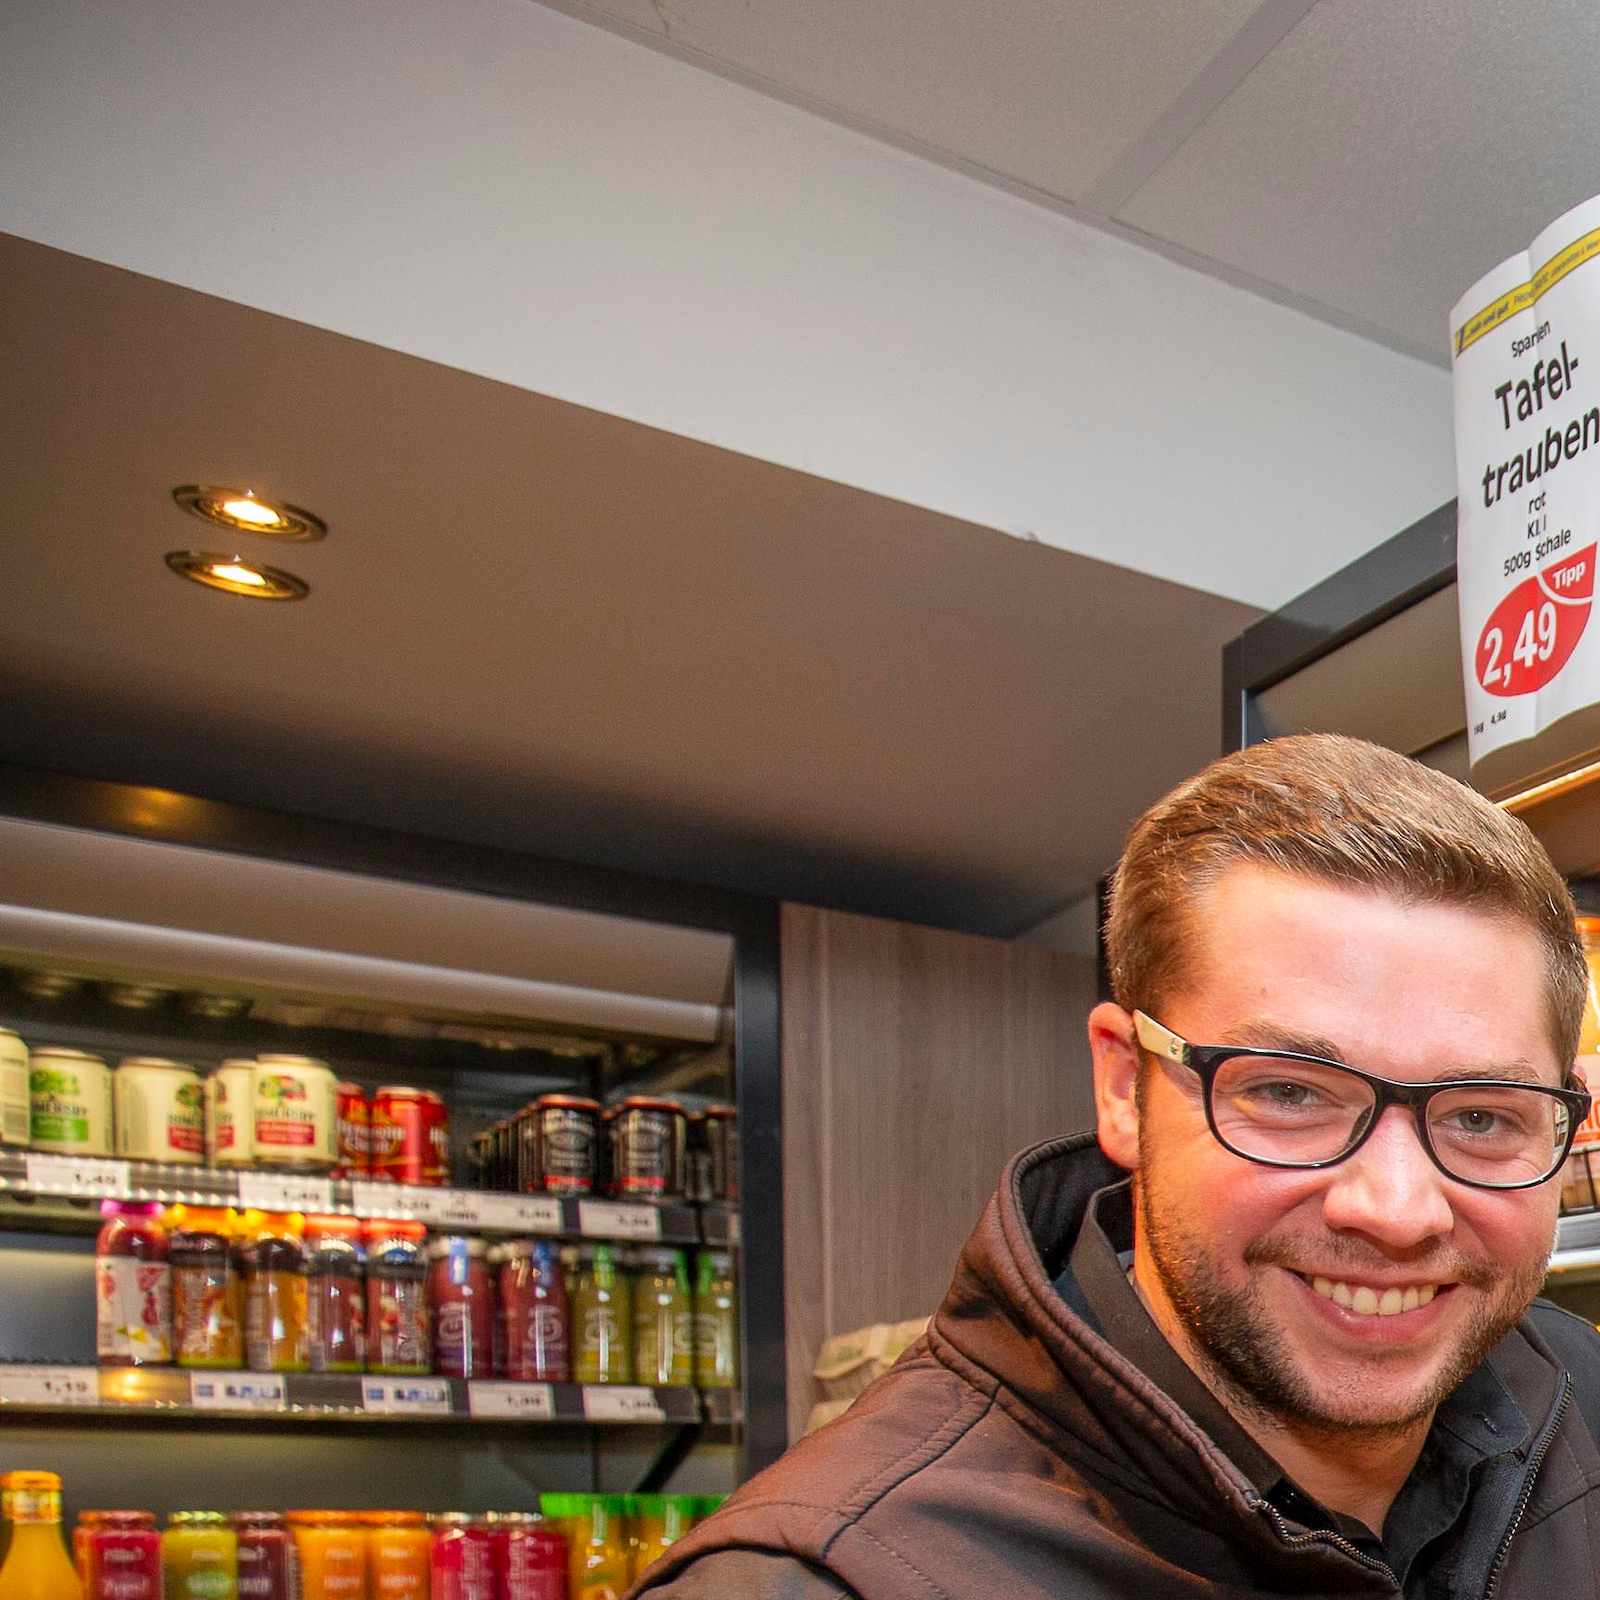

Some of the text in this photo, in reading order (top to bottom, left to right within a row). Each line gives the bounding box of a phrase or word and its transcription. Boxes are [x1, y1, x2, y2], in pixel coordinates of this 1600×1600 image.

[1511, 320, 1551, 358] Spanien
[1494, 340, 1579, 430] Tafel-
[1503, 527, 1572, 578] 500g Schale
[1552, 560, 1587, 589] Tipp
[1481, 602, 1557, 687] 2,49
